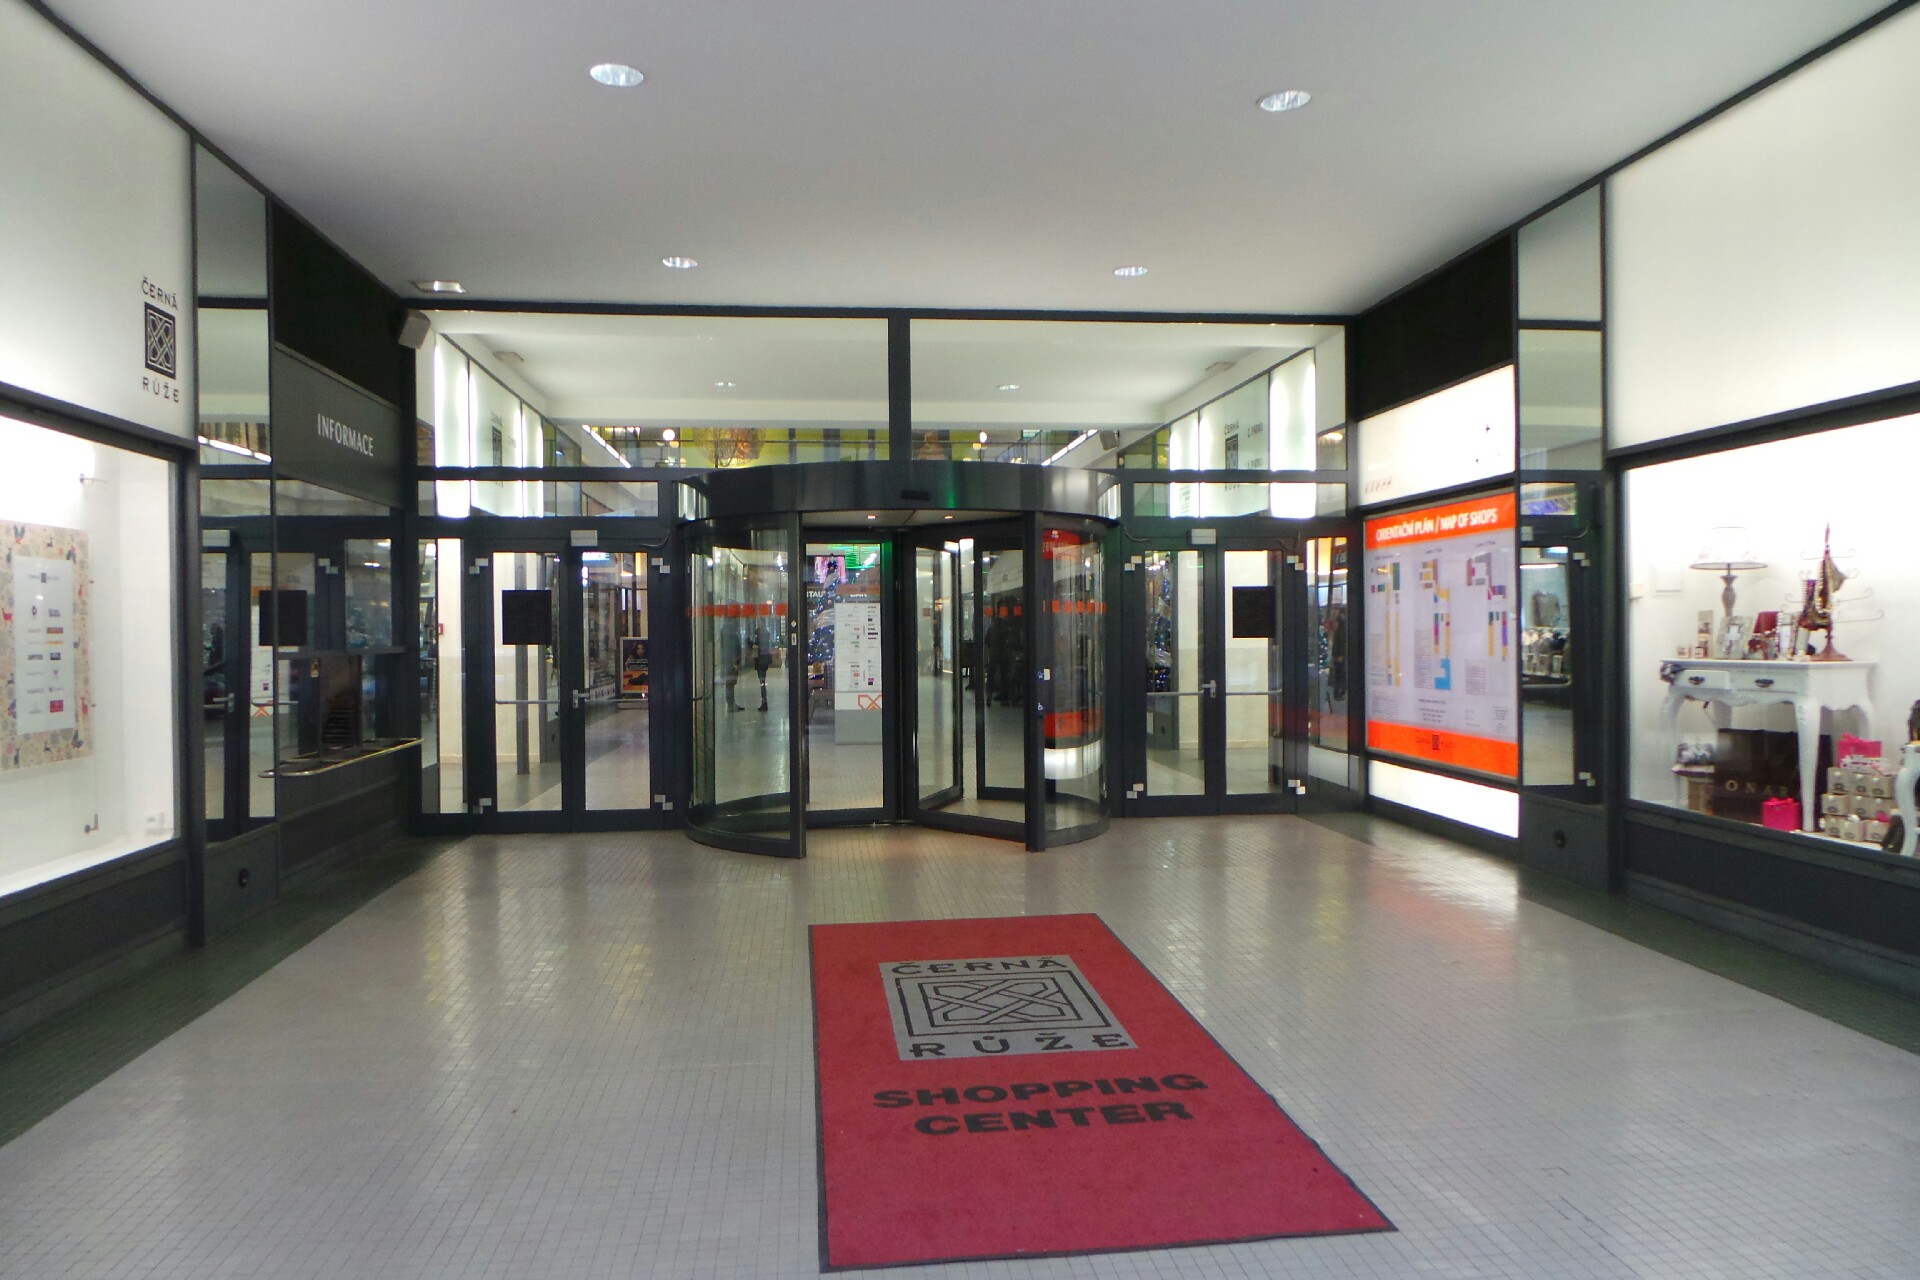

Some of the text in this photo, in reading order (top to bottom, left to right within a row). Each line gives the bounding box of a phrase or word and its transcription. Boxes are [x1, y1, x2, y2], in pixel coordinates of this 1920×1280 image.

[317, 412, 374, 457] INFORMACE
[1457, 512, 1469, 528] OF
[1469, 508, 1498, 525] SHOPS
[892, 957, 1067, 975] ČERNÁ
[909, 1032, 1129, 1058] RŮŽE
[873, 1074, 1208, 1108] SHOPPING
[915, 1101, 1194, 1135] CENTER
